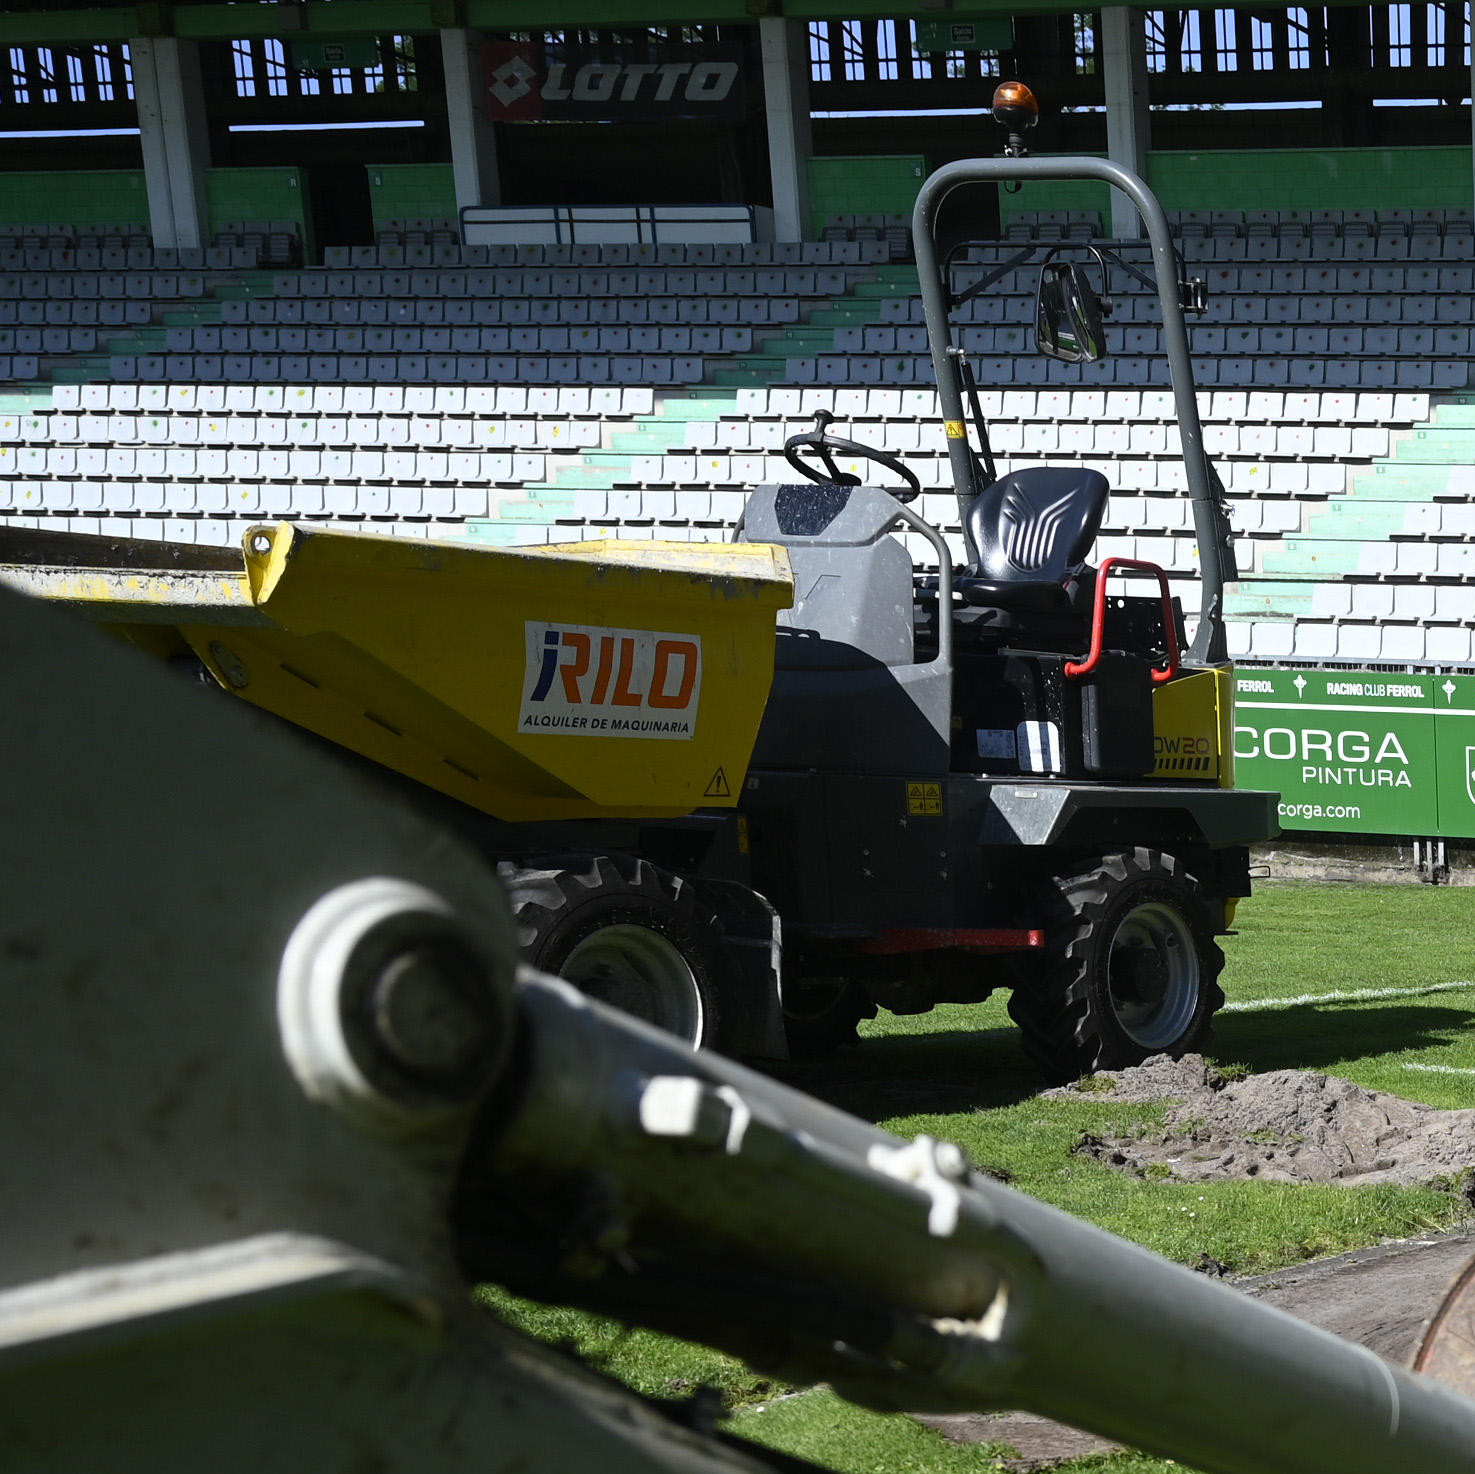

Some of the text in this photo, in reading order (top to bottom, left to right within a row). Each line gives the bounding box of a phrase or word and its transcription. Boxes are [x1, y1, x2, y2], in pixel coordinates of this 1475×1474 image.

[540, 62, 739, 102] LOTTO
[1237, 679, 1274, 694] FERROL
[1327, 682, 1424, 698] RACING CLUB FERROL
[524, 715, 689, 733] ALQUILER DE MAQUINARIA
[1234, 726, 1410, 766] CORGA
[1302, 766, 1412, 788] PINTURA
